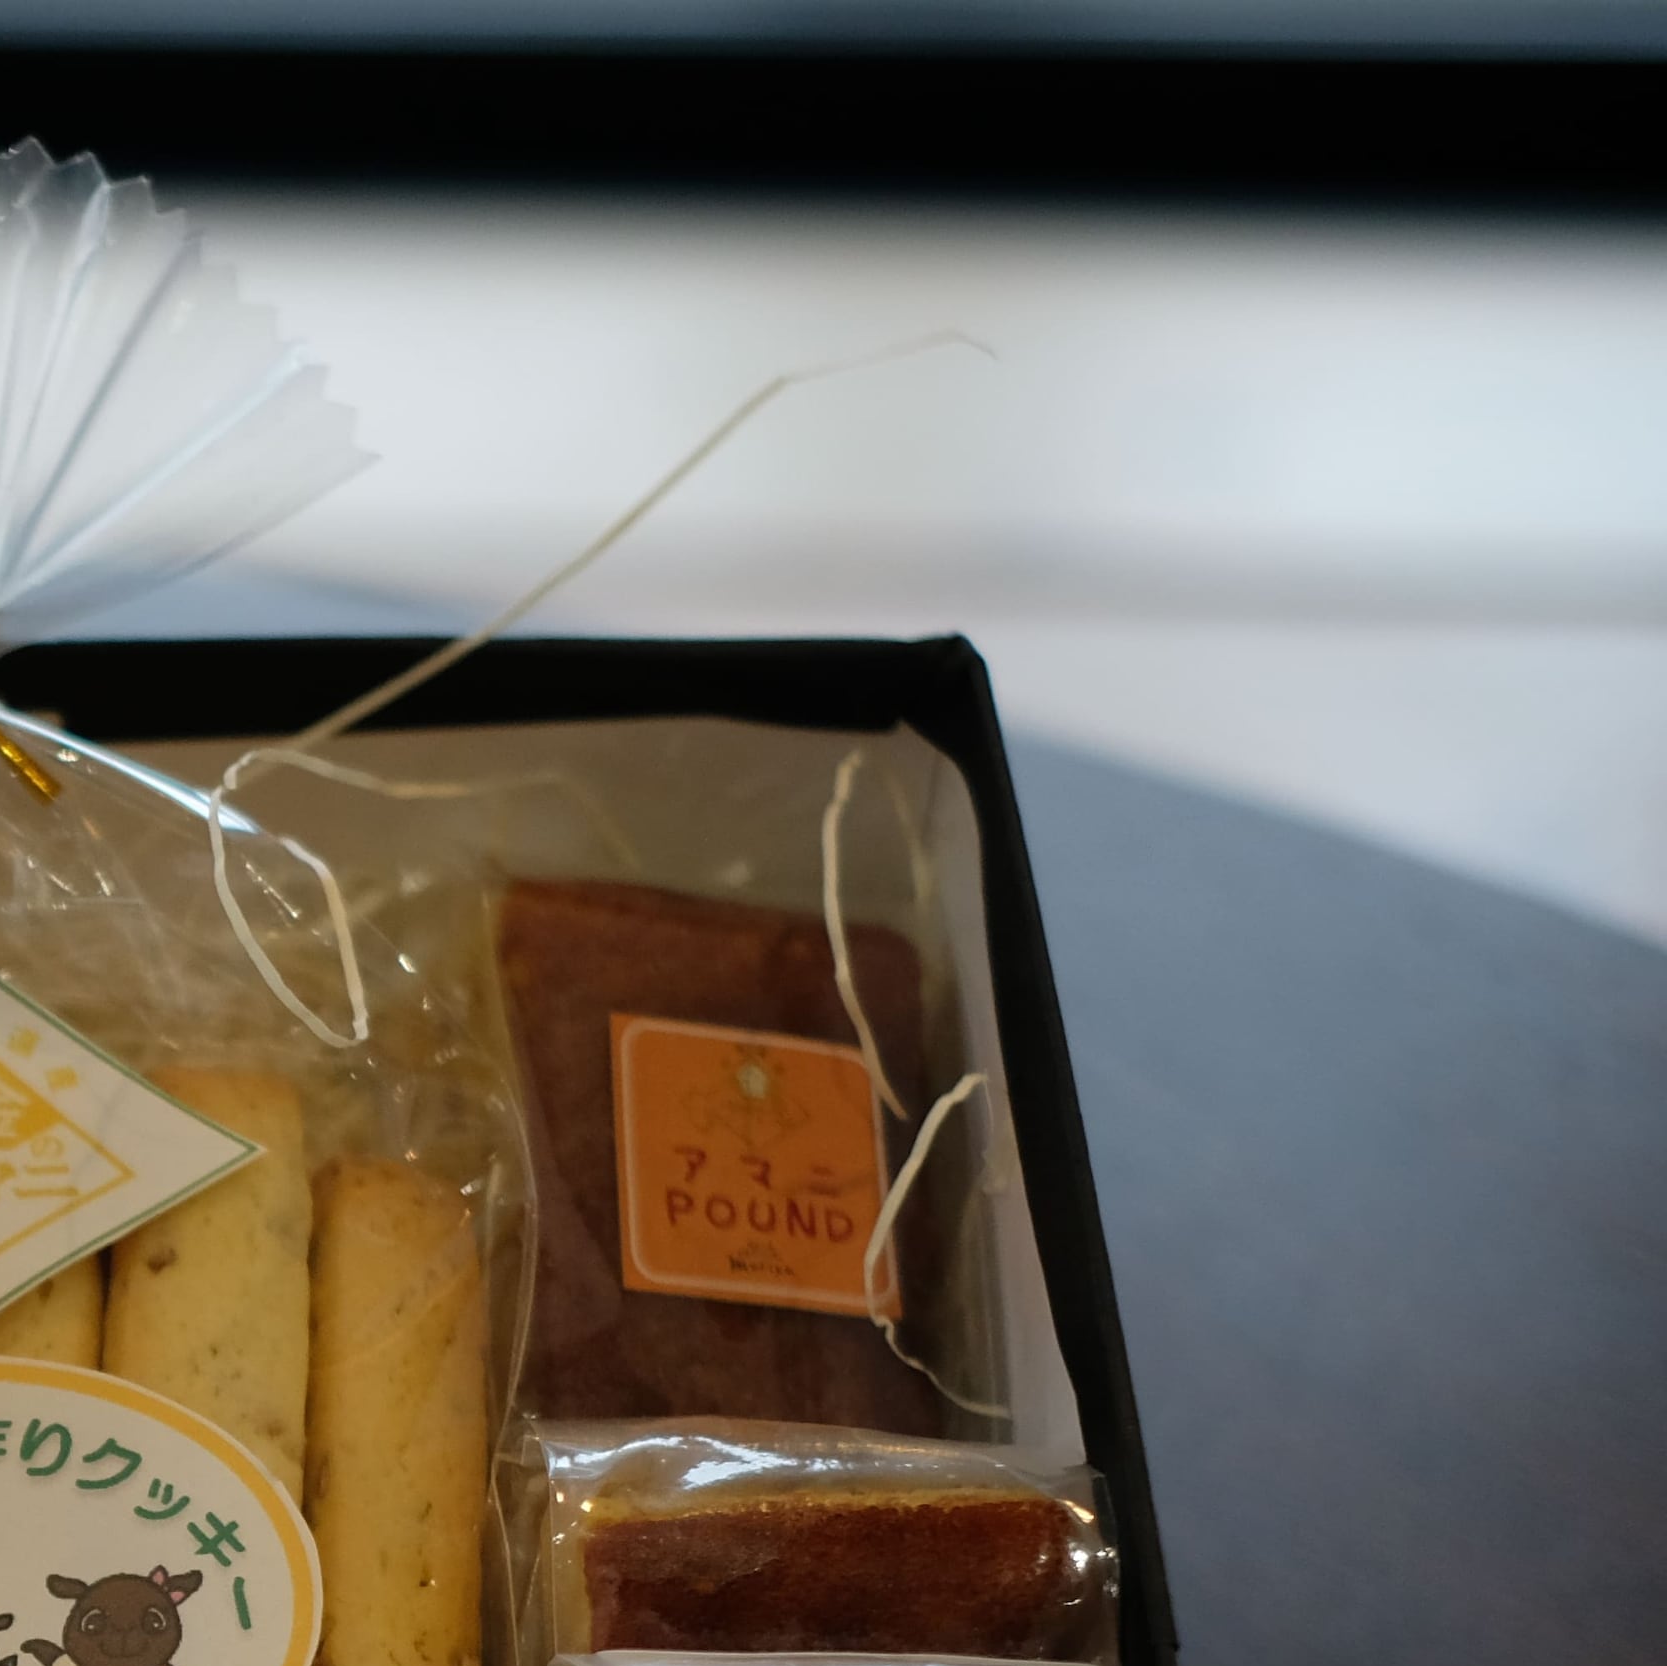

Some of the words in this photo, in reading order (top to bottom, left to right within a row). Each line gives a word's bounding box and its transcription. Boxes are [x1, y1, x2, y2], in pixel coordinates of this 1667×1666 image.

[673, 1145, 840, 1196] アマニ
[666, 1186, 854, 1242] POUND
